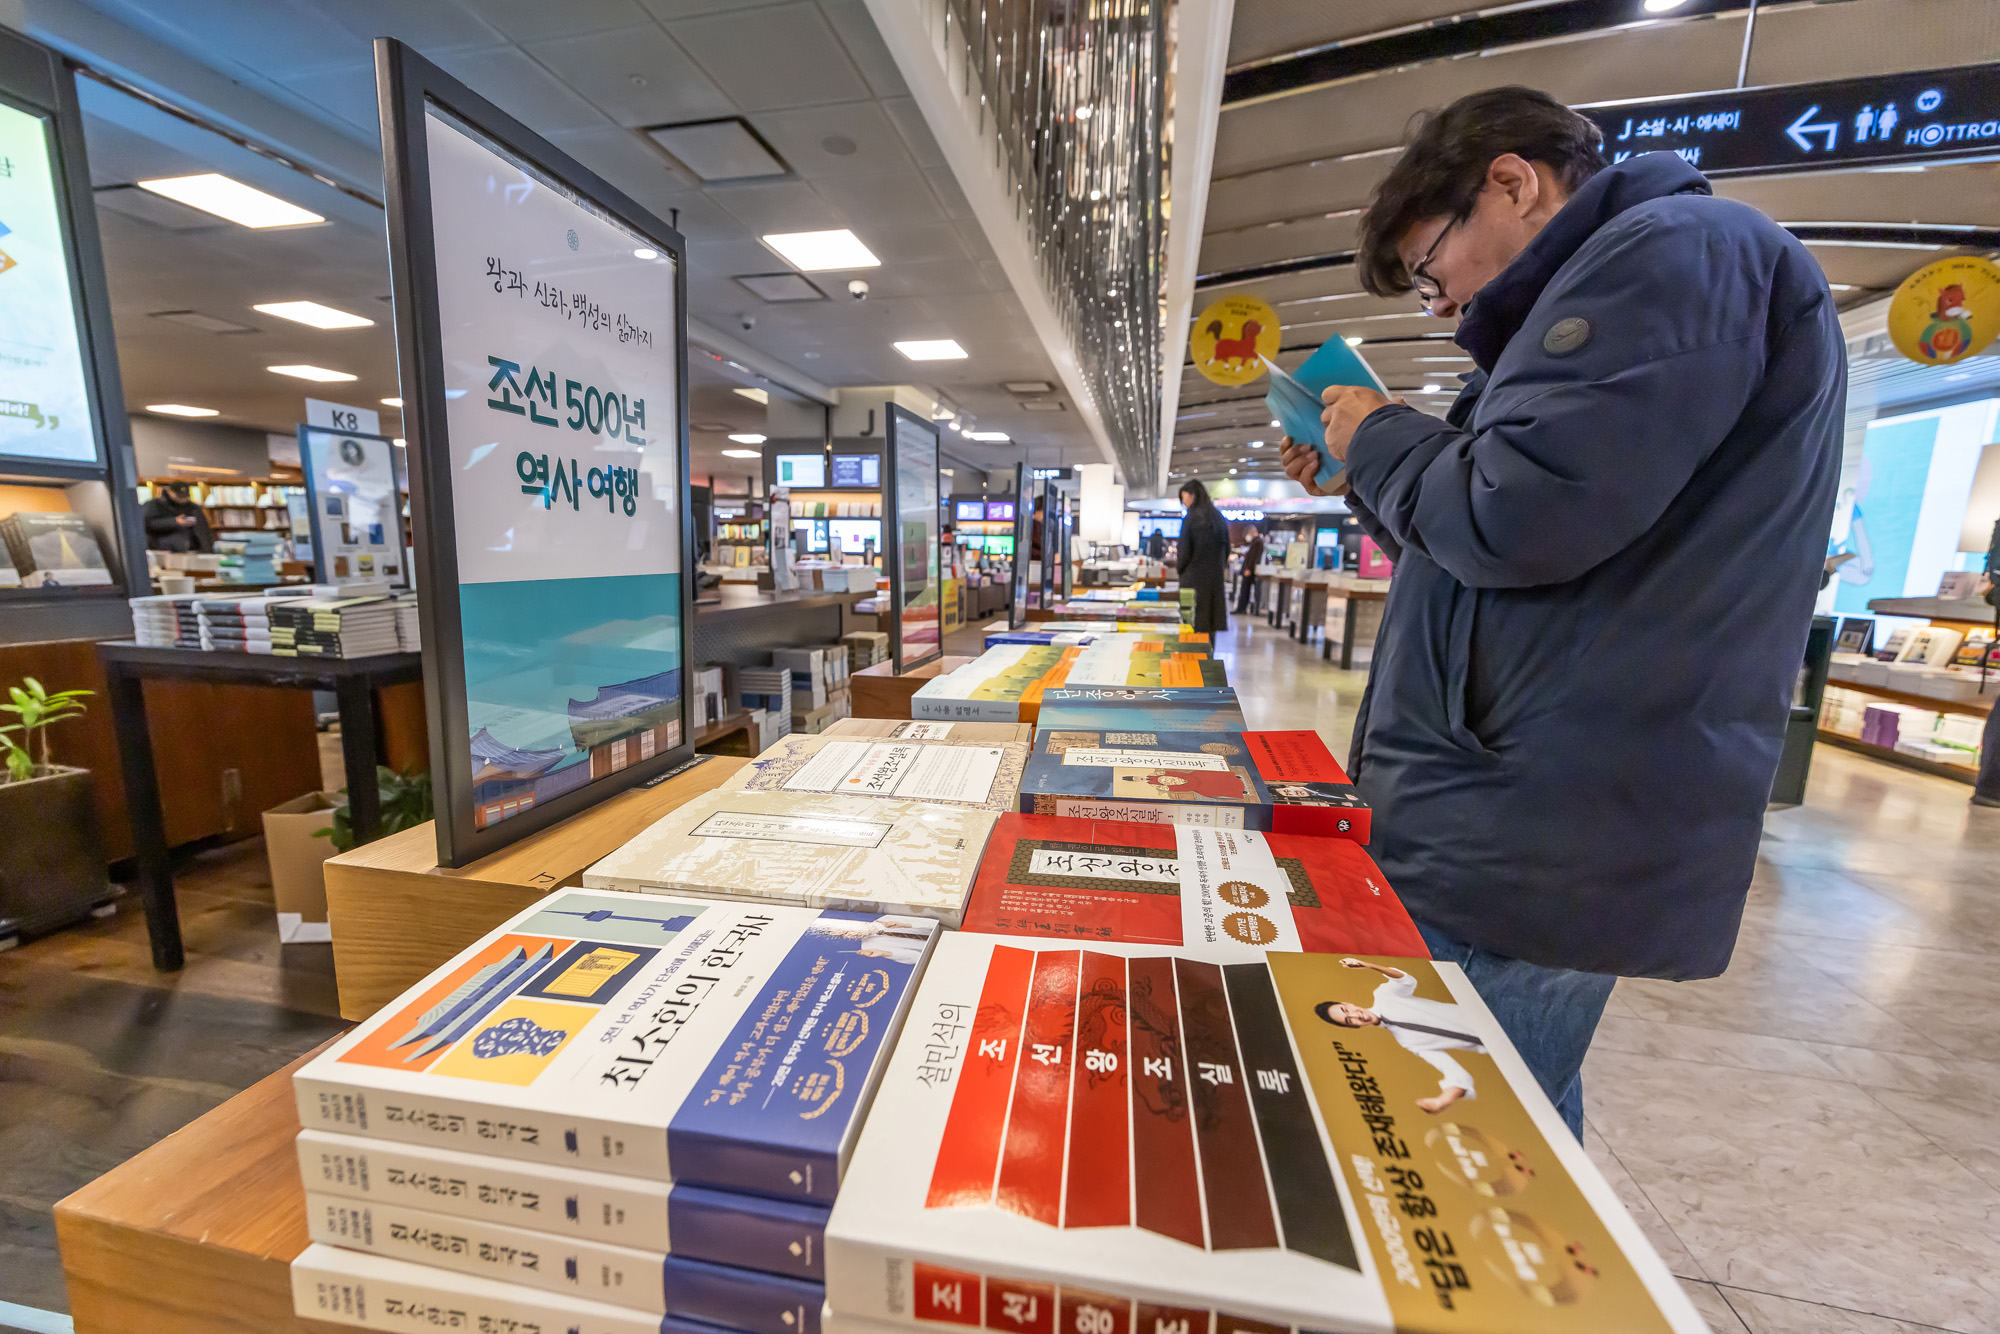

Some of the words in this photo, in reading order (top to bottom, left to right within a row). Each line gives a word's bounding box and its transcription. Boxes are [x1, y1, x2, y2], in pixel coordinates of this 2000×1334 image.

[1617, 118, 1634, 141] J
[487, 257, 528, 298] 왕과
[617, 314, 652, 350] 삶까지
[332, 411, 359, 431] K8
[487, 355, 559, 428] 조선
[566, 379, 647, 446] 500년
[860, 409, 874, 436] J
[516, 451, 582, 511] 역사
[587, 464, 639, 517] 여행
[922, 705, 930, 714] 나
[933, 706, 950, 715] 사용
[955, 706, 980, 716] 설명서
[1052, 688, 1179, 701] 단종애사
[866, 746, 912, 790] 조선왕조실록
[1077, 755, 1210, 767] 조선왕조실록
[1068, 804, 1163, 823] 조선왕조실록
[1202, 907, 1213, 923] 고증의
[1237, 918, 1248, 937] 2017년
[628, 983, 662, 1011] 역사가
[655, 958, 687, 983] 단숨에
[680, 929, 716, 957] 이해되는
[600, 974, 720, 1092] 최소한의
[701, 914, 774, 968] 한국사
[916, 1003, 971, 1088] 설민석의
[978, 1038, 1007, 1061] 조
[1031, 1044, 1062, 1066] 선
[1085, 1048, 1118, 1074] 왕
[1143, 1056, 1173, 1081] 조
[1198, 1062, 1234, 1086] 실
[1256, 1068, 1291, 1094] 록
[1384, 1166, 1438, 1219] 항상
[933, 1281, 962, 1314] 조
[1003, 1292, 1037, 1323] 선
[1076, 1304, 1114, 1334] 왕
